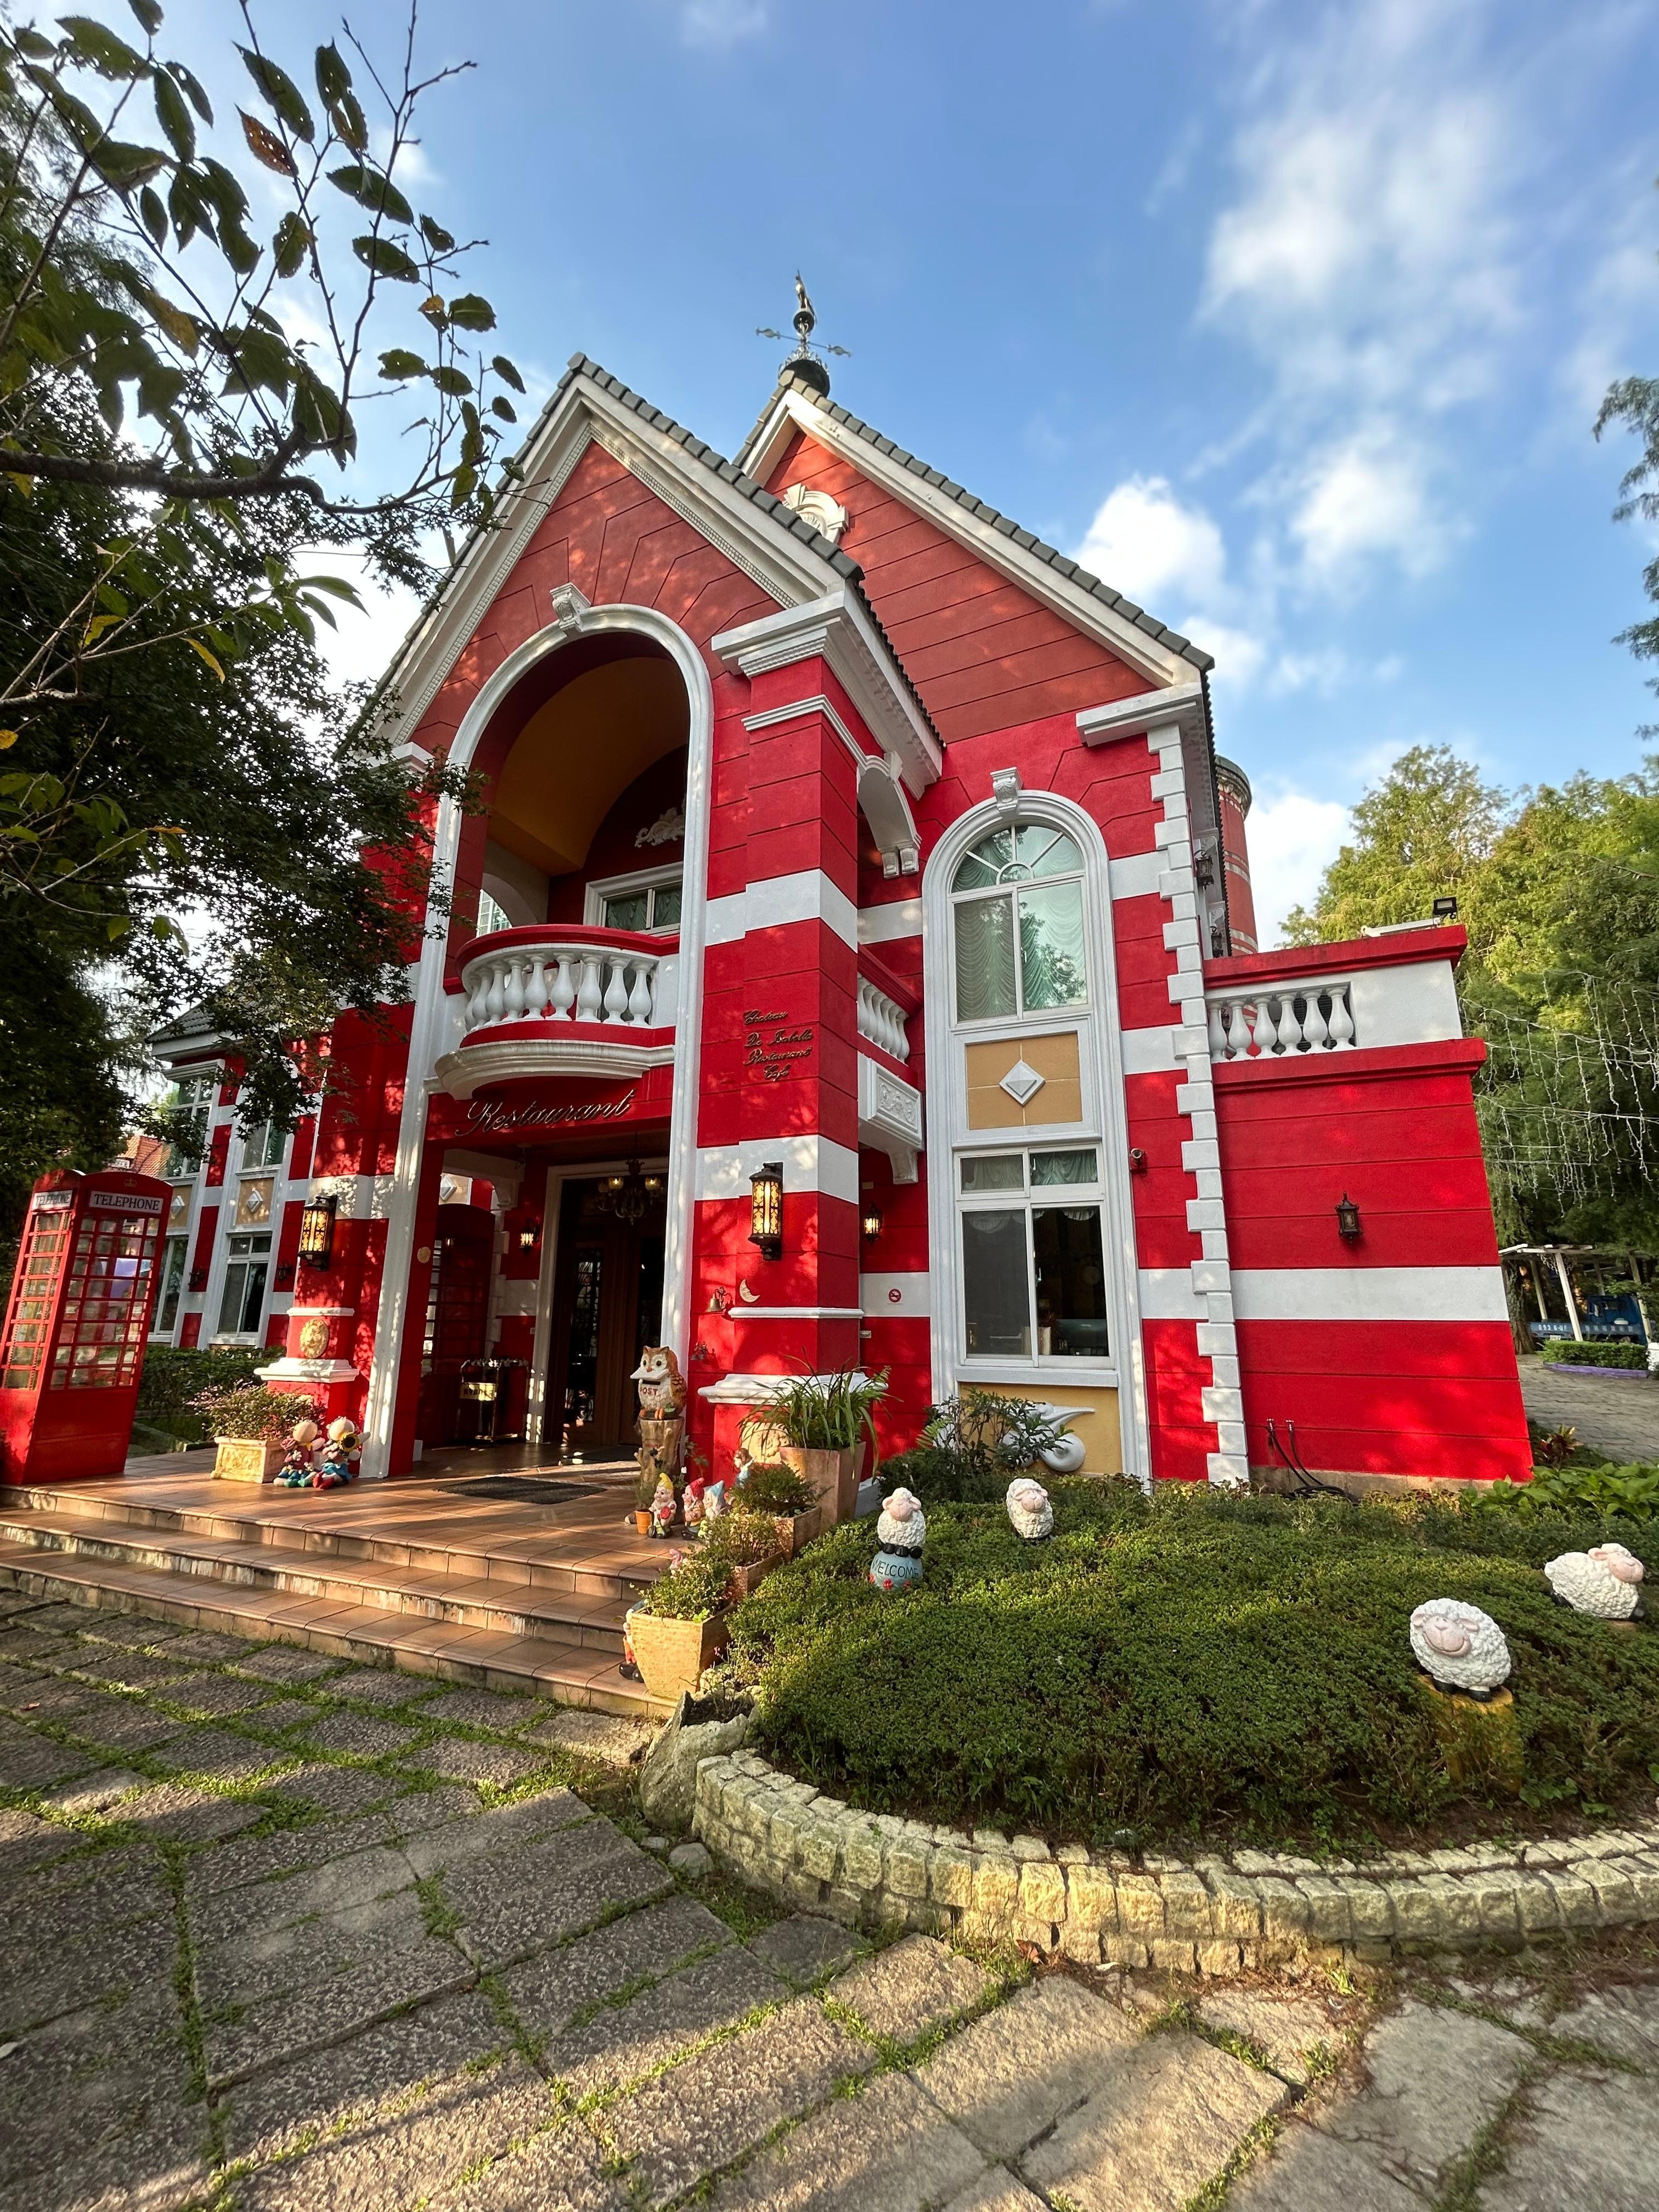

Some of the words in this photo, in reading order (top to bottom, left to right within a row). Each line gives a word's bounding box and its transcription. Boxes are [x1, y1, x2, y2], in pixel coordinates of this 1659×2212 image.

[743, 1032, 763, 1047] De
[742, 1046, 812, 1066] Restaurant
[455, 1088, 638, 1137] Restaurant
[36, 1193, 71, 1206] TELEPHONE
[94, 1193, 160, 1211] TELEPHONE
[872, 1559, 919, 1579] WELCOME
